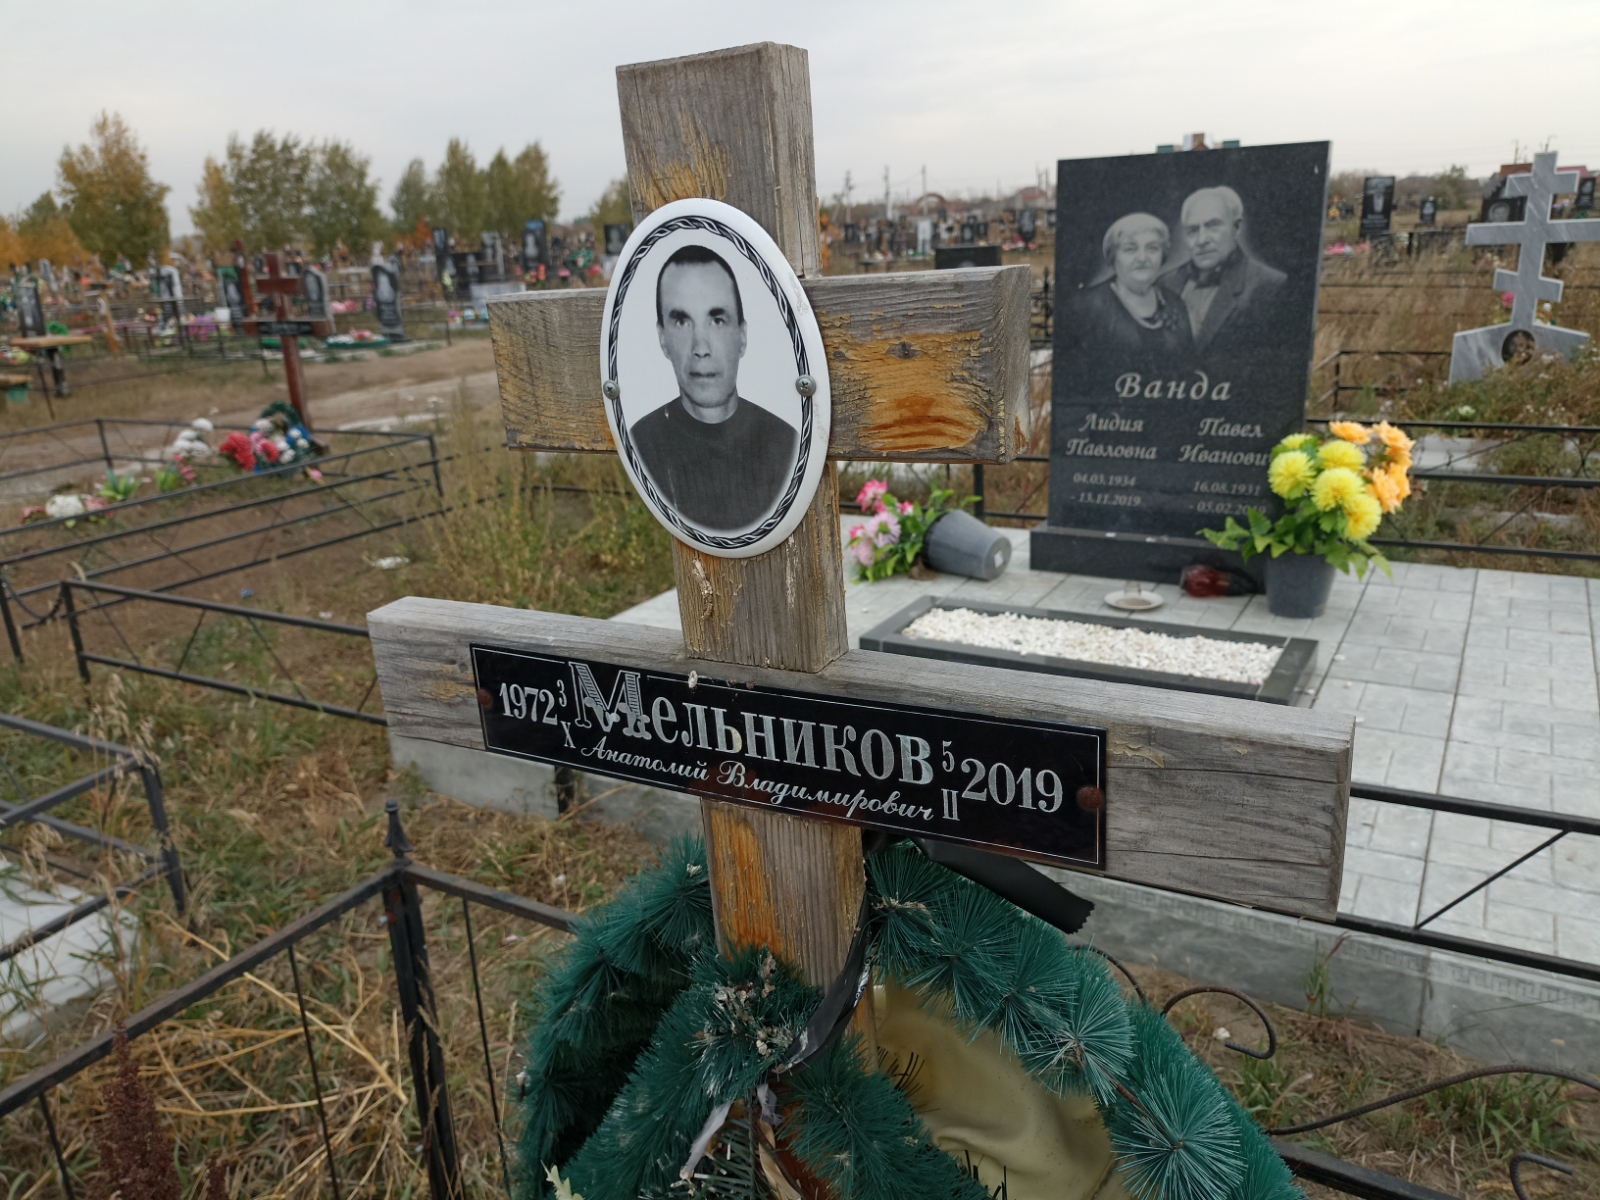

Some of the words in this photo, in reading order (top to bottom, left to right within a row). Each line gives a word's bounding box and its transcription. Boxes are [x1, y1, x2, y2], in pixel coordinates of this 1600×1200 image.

[1115, 370, 1231, 401] Ванда
[1078, 412, 1144, 433] Лидия
[1198, 416, 1264, 438] Павел
[1065, 438, 1158, 460] Павловна
[1178, 443, 1273, 466] Иванови
[499, 682, 558, 725] 1972
[556, 679, 567, 707] 3
[568, 661, 934, 785] Мельников
[942, 740, 956, 773] 5
[581, 735, 710, 781] Анатолий
[716, 760, 934, 821] Владимирович
[961, 758, 1064, 813] 2019
[940, 788, 961, 821] II
